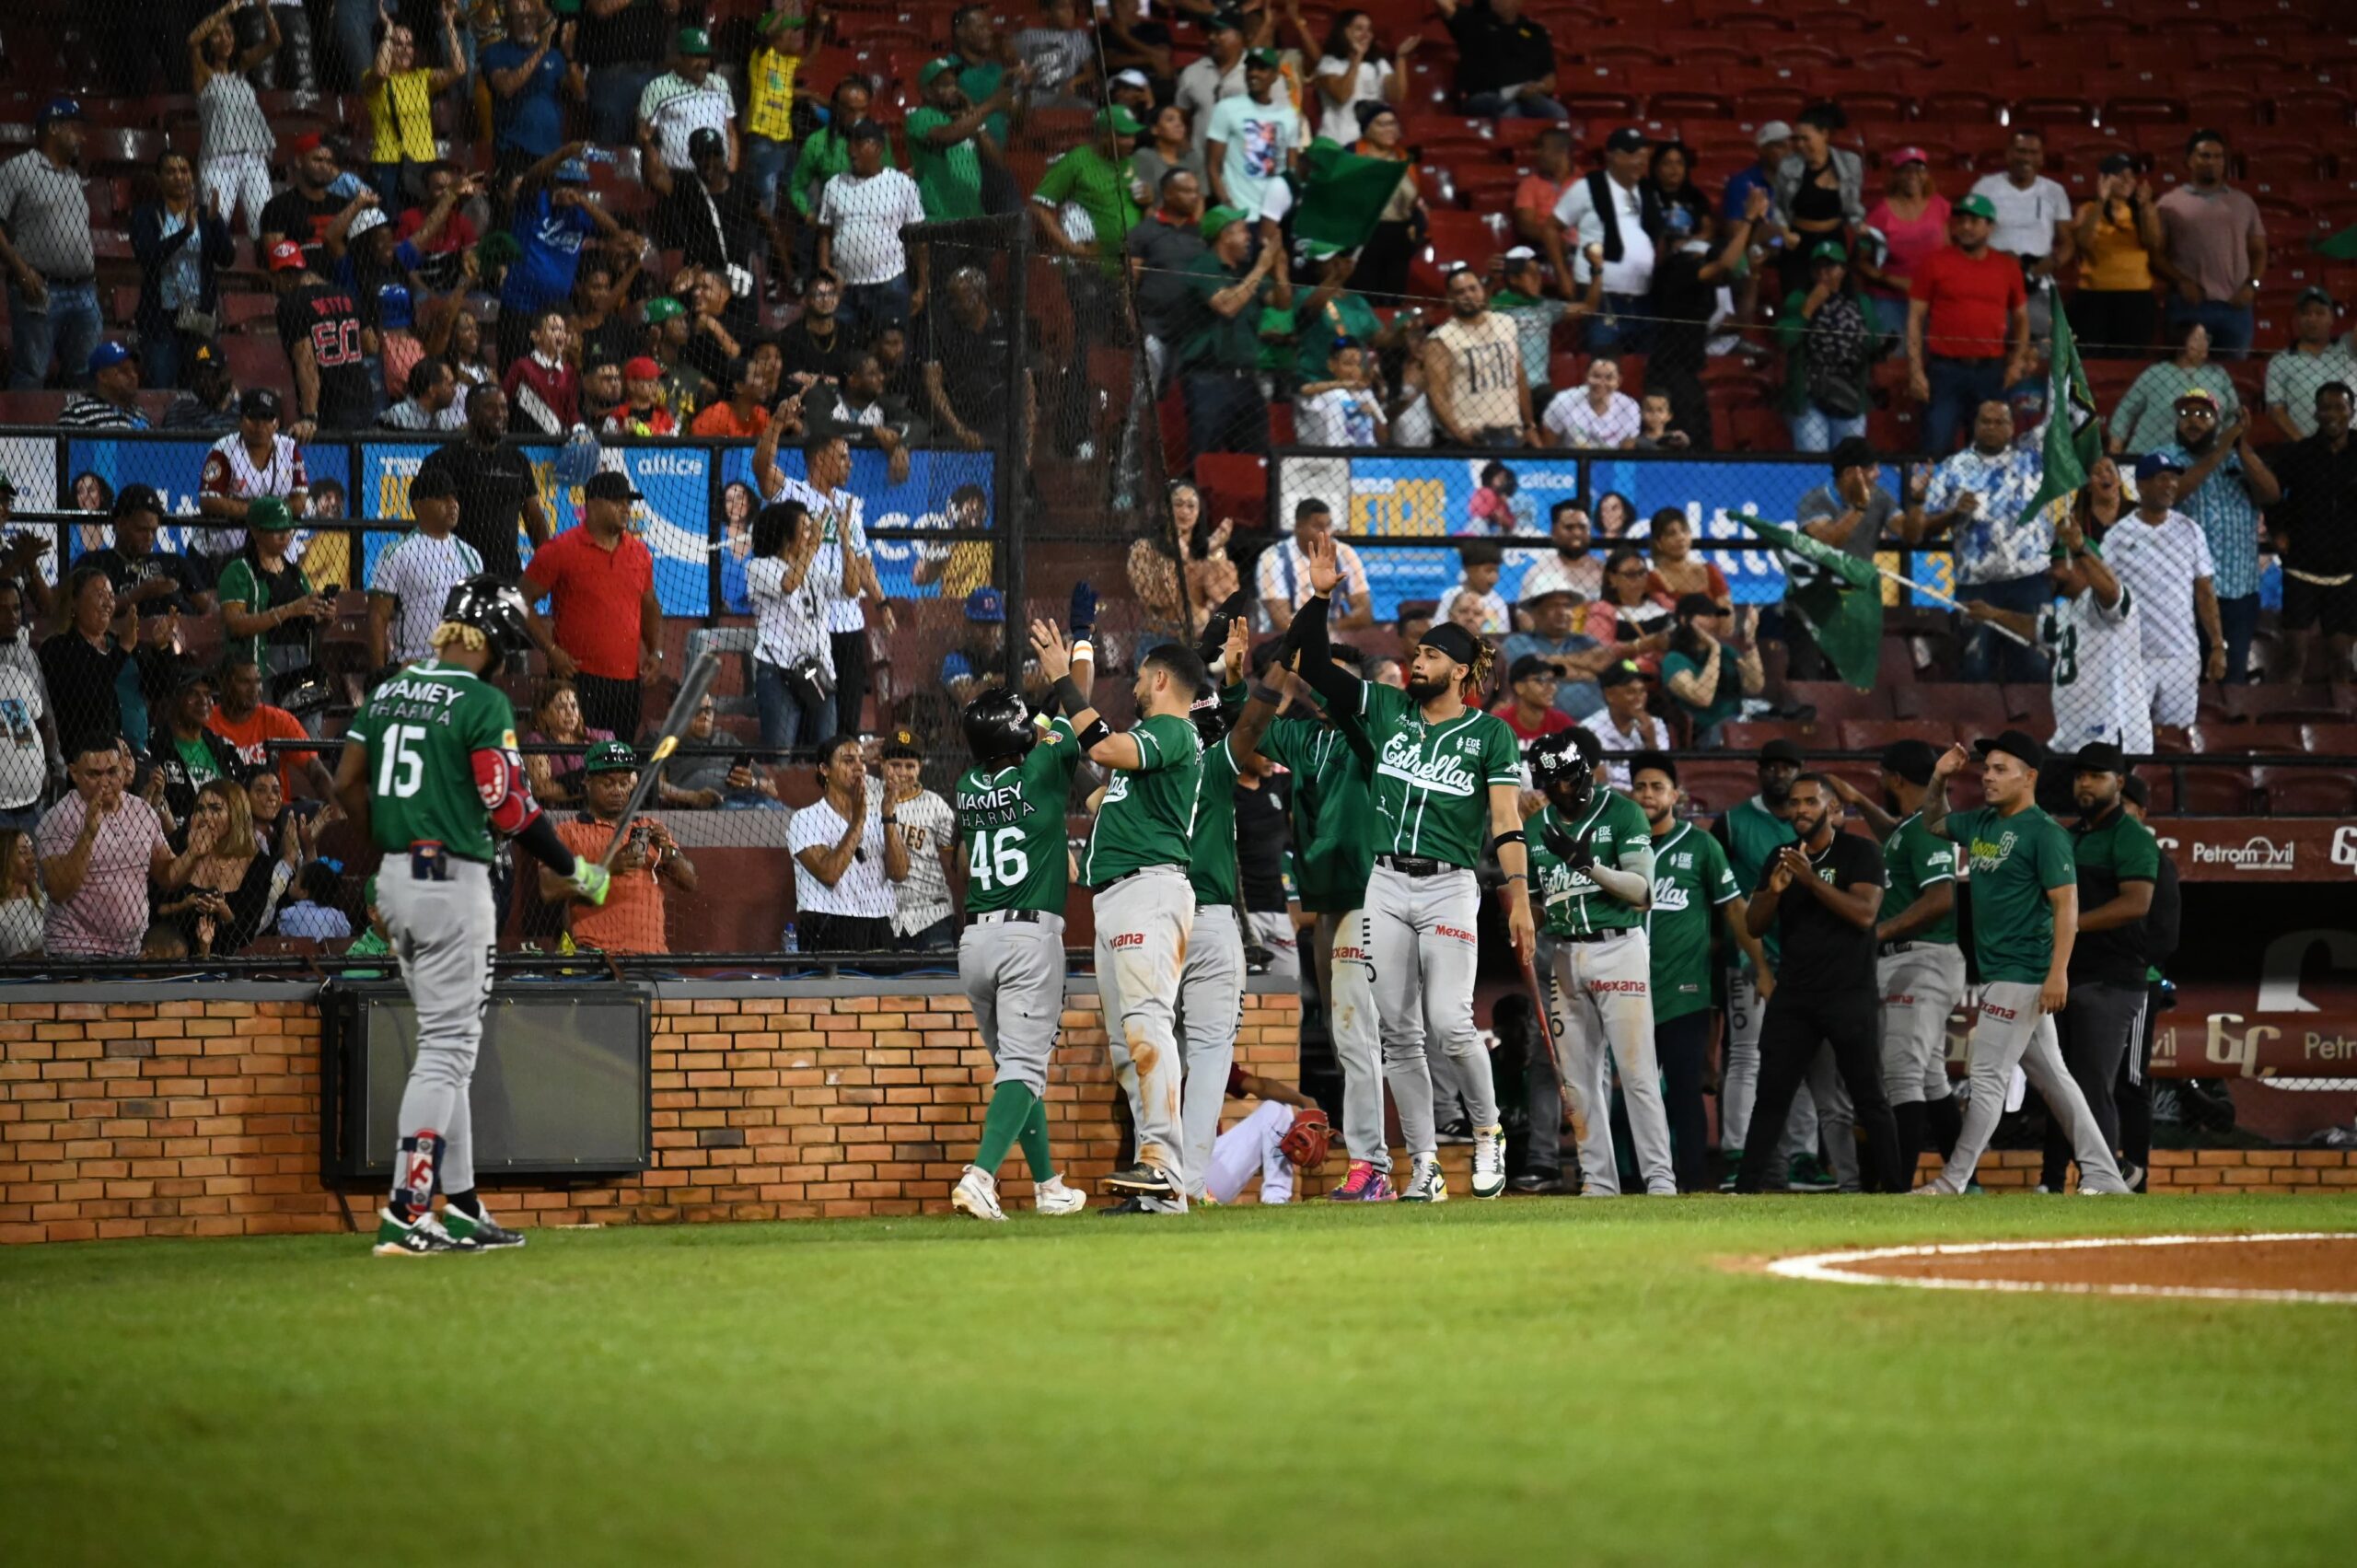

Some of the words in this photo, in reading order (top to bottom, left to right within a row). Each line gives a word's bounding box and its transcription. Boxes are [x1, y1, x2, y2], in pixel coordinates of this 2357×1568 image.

[377, 723, 426, 798] 15
[1382, 731, 1475, 792] Estrellas
[958, 781, 1022, 811] MAMEY
[962, 800, 1036, 828] HARMA
[970, 826, 1029, 891] 46
[1589, 980, 1646, 993] Mexana
